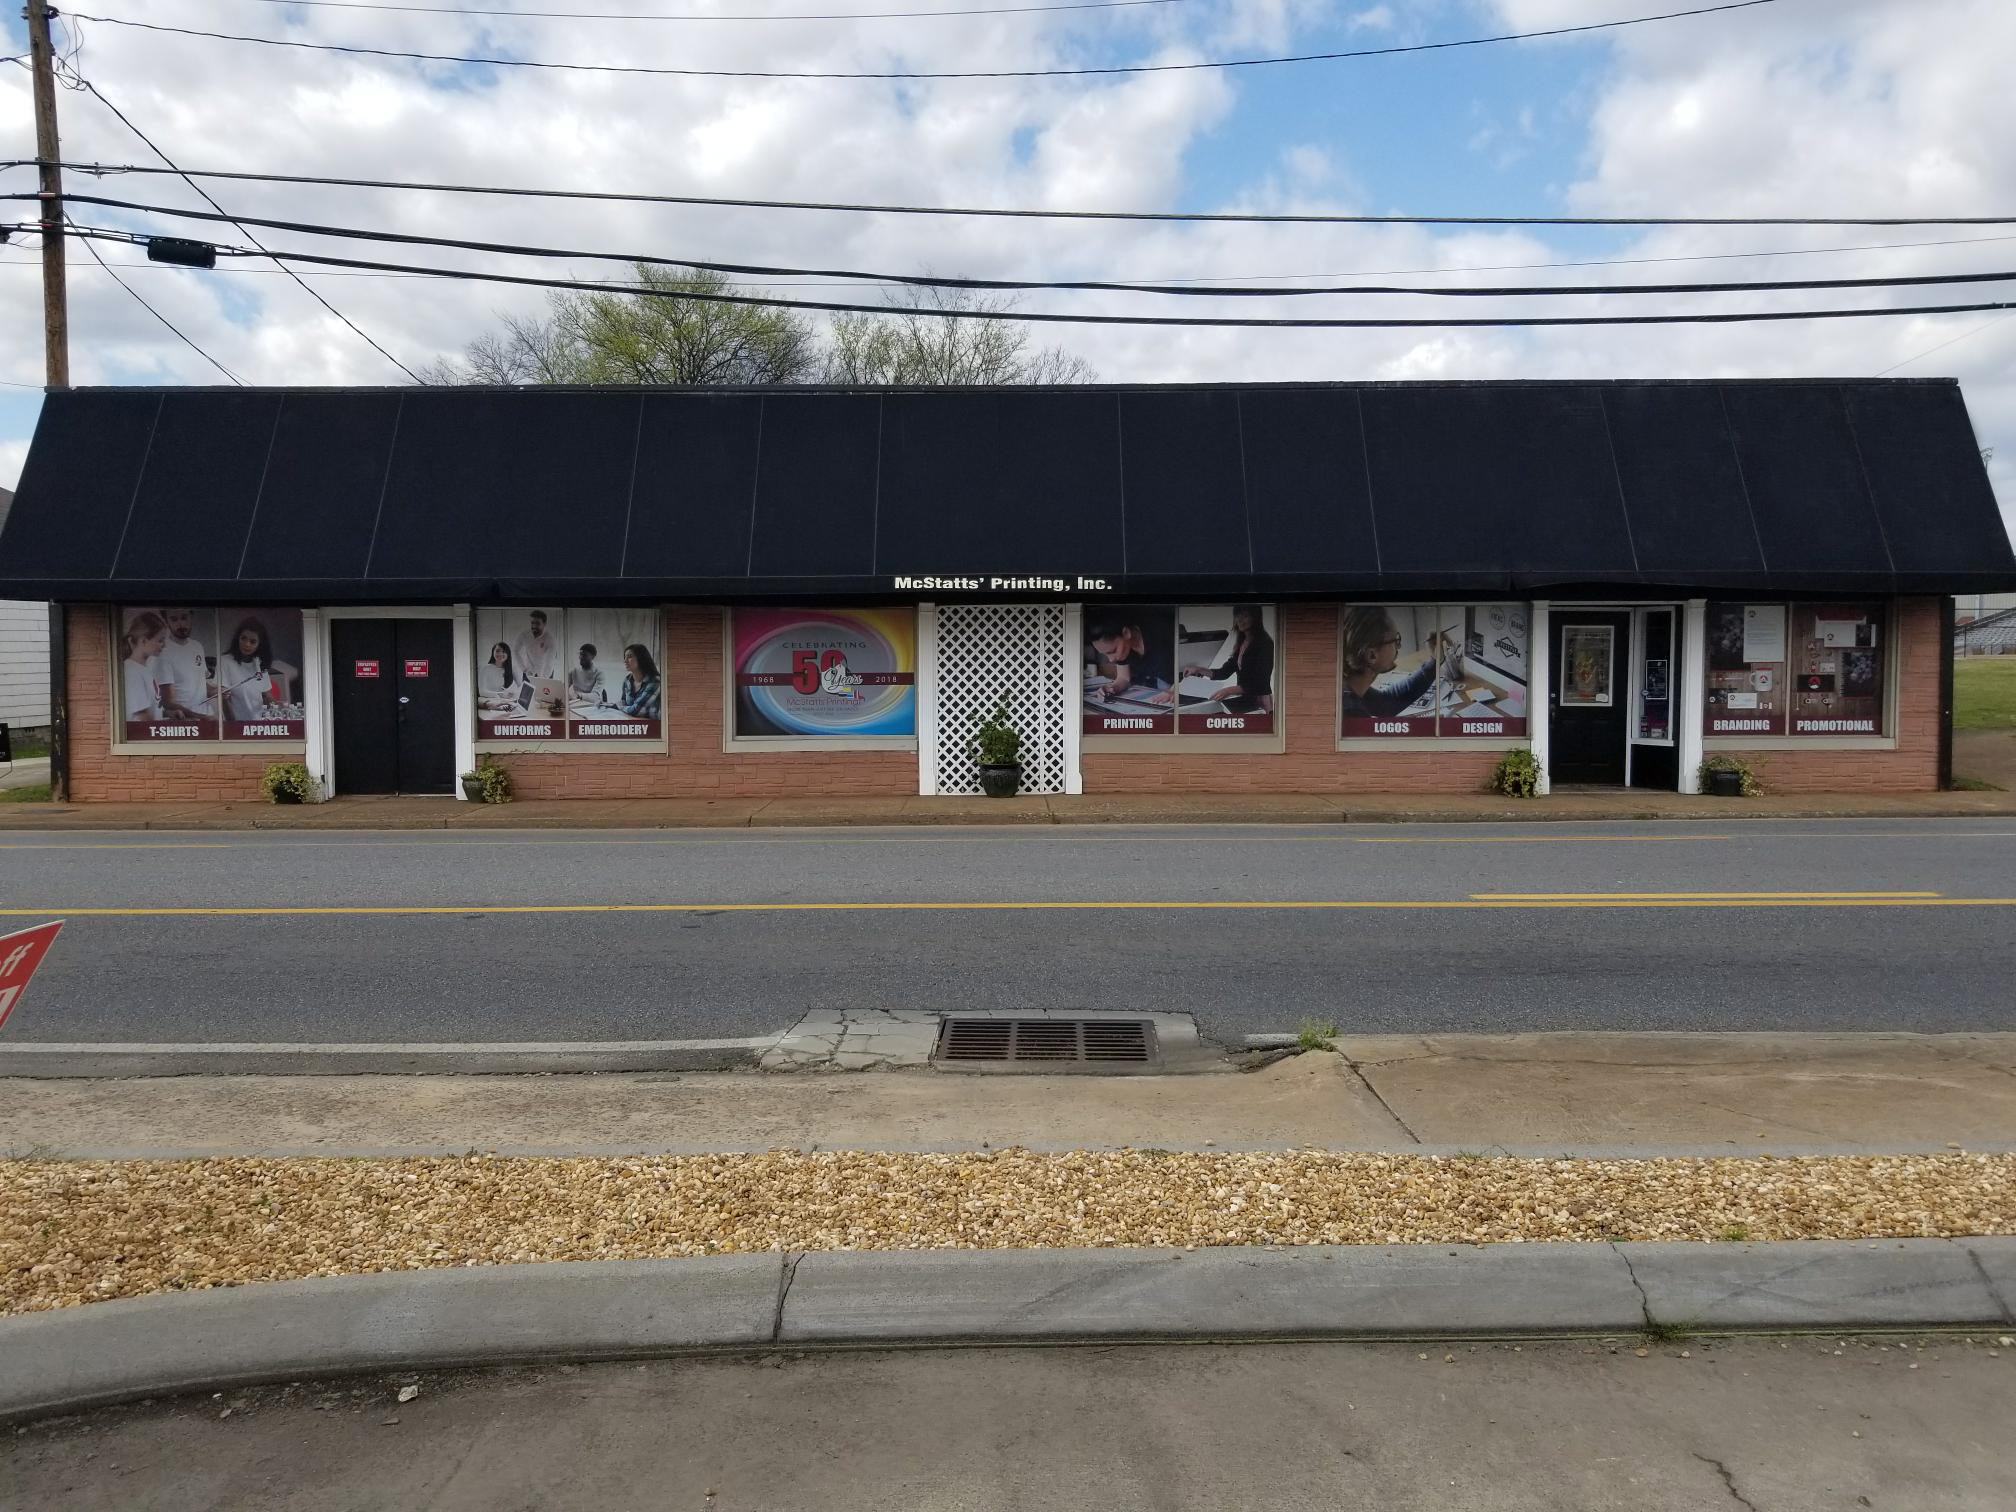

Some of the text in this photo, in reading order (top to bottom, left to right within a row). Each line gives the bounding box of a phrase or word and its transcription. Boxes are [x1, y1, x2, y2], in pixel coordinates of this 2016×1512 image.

[991, 577, 1070, 591] Printing,
[1077, 576, 1112, 590] Inc.
[782, 641, 867, 649] CELEBRATING
[792, 650, 849, 695] 50
[824, 668, 863, 690] Years
[1104, 718, 1153, 729] PRINTING
[1206, 718, 1245, 729] COPIES
[1374, 722, 1409, 733] LOGOS
[1463, 722, 1503, 733] DESIGN
[1713, 719, 1770, 731] BRANDING
[1797, 720, 1874, 731] PROMOTIONAL
[149, 726, 199, 737] T-SHIRTS
[242, 725, 290, 736] APPAREL
[494, 725, 552, 735] UNIFORMS
[578, 724, 649, 735] EMBROIDERY
